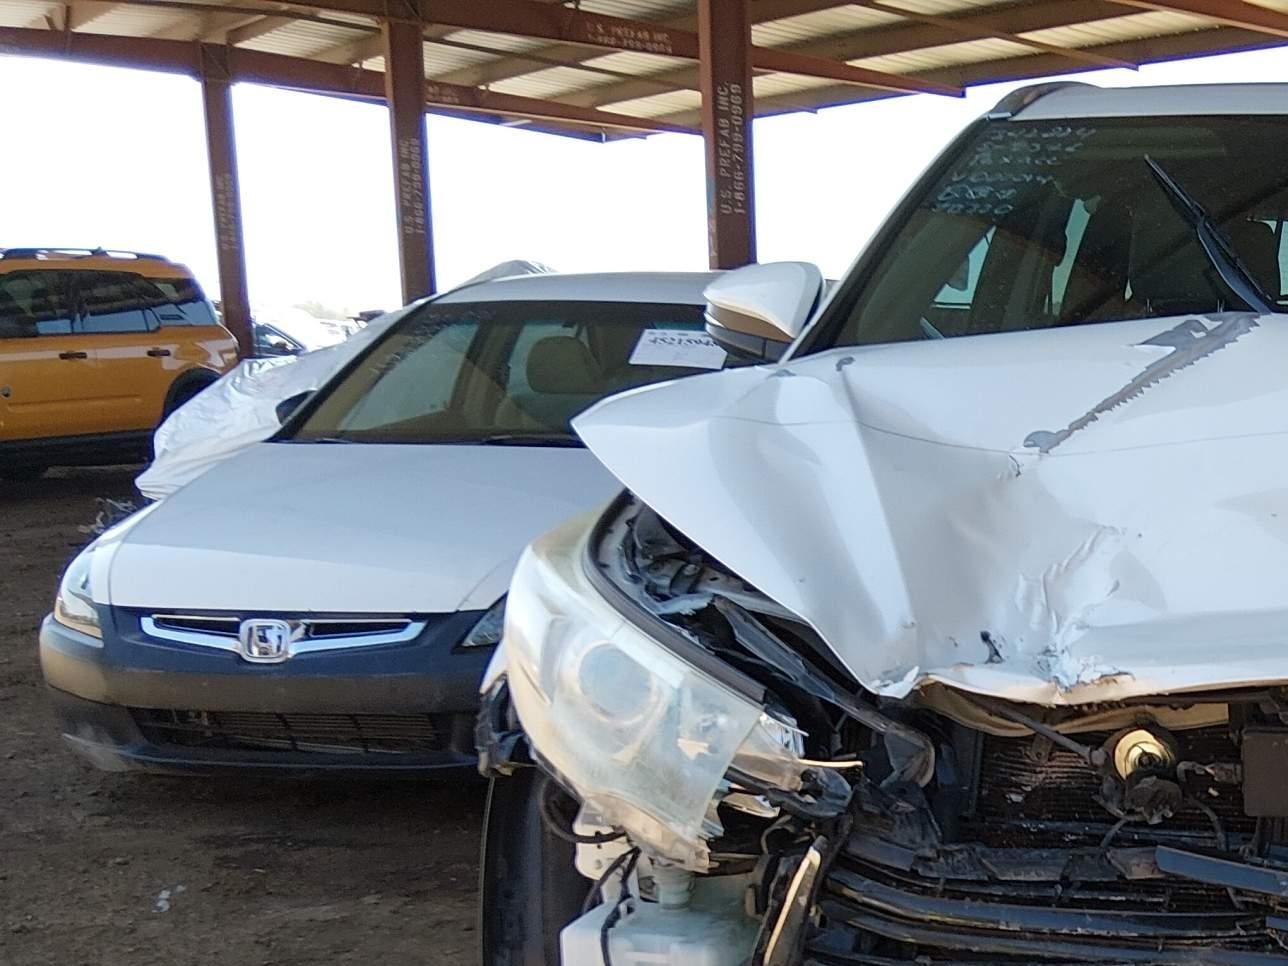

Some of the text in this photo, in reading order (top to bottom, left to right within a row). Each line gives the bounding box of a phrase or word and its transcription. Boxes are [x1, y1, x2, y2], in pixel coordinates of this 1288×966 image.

[717, 80, 732, 215] U.S. PREFAB INC.
[730, 83, 746, 214] 1-866-799-0969
